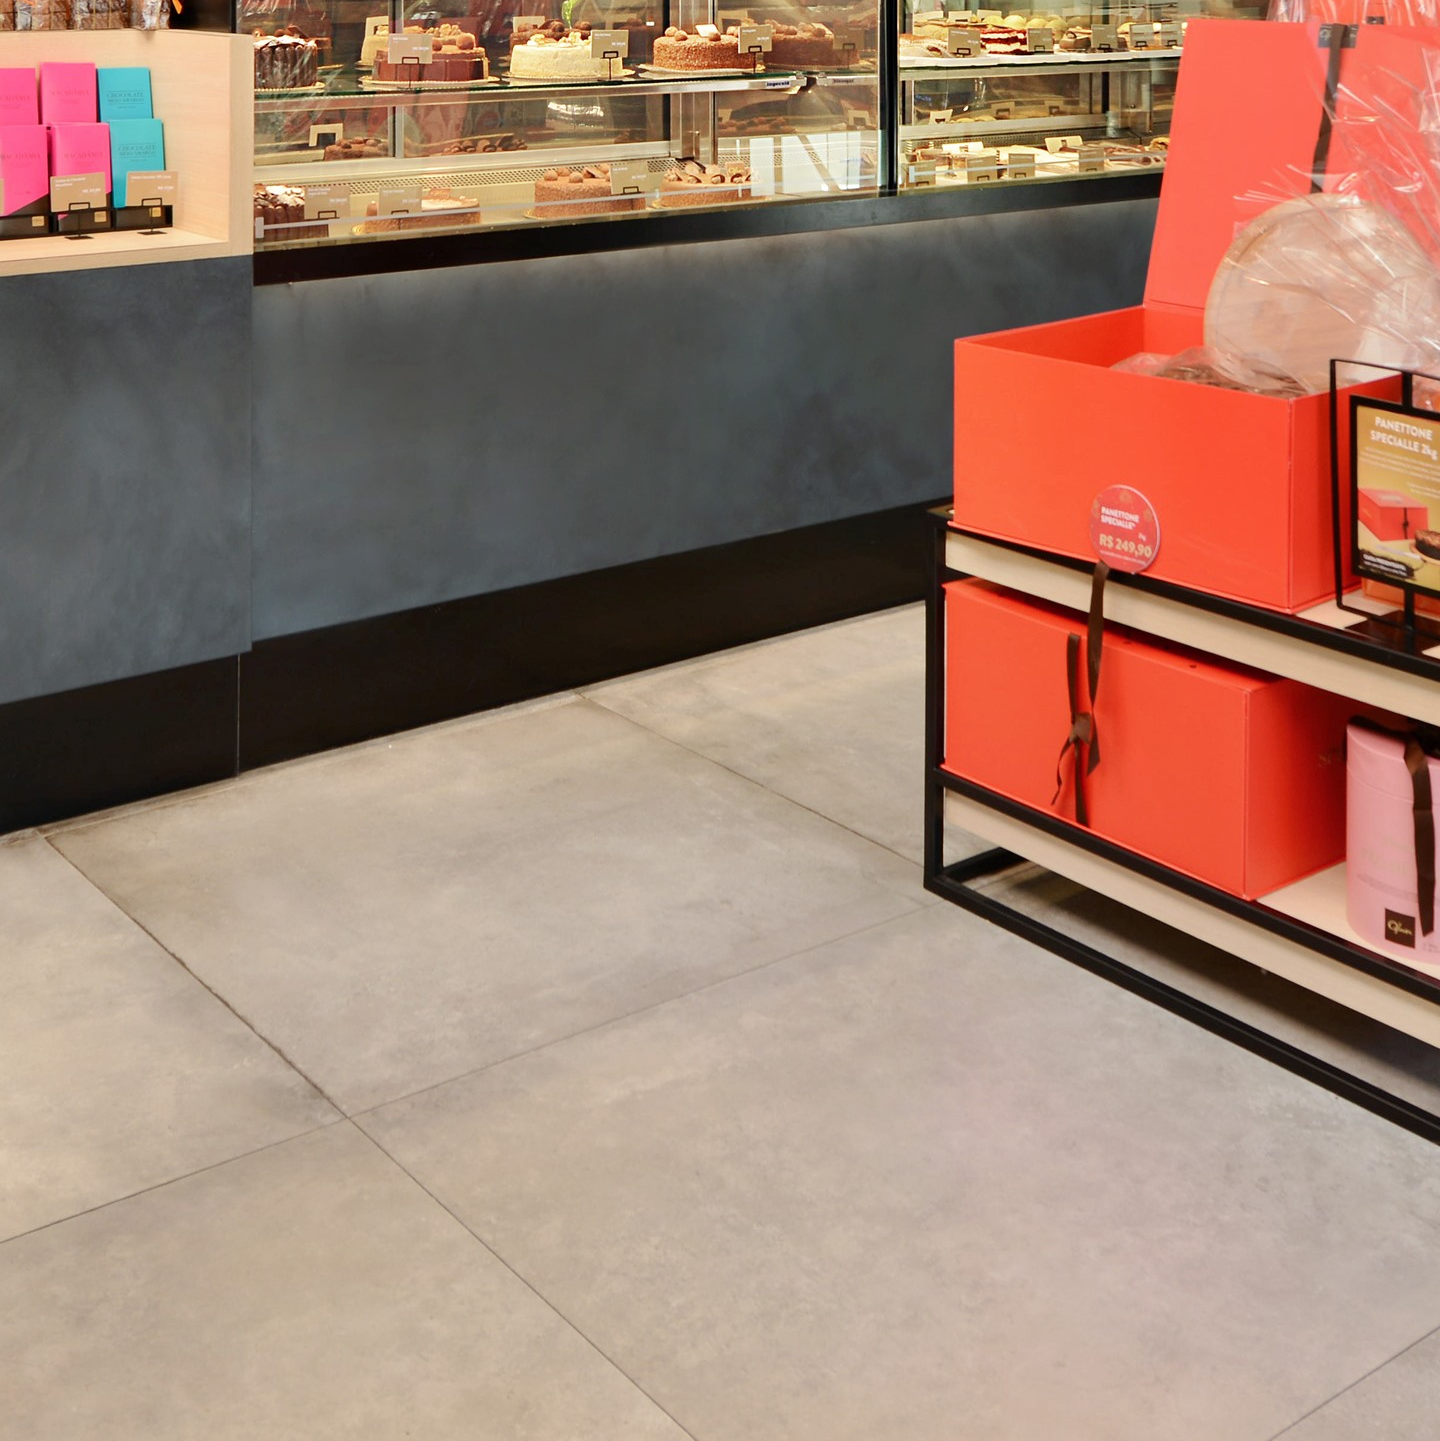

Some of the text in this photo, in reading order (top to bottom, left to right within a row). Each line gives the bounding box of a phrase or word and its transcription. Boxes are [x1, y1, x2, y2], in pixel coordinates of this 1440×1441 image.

[1374, 416, 1433, 441] PANETTONE
[1369, 430, 1439, 461] SPECIALLE 2kg
[1101, 506, 1139, 523] PANETTONE
[1099, 533, 1153, 558] R$ 249,90
[1387, 919, 1414, 936] Ofner
